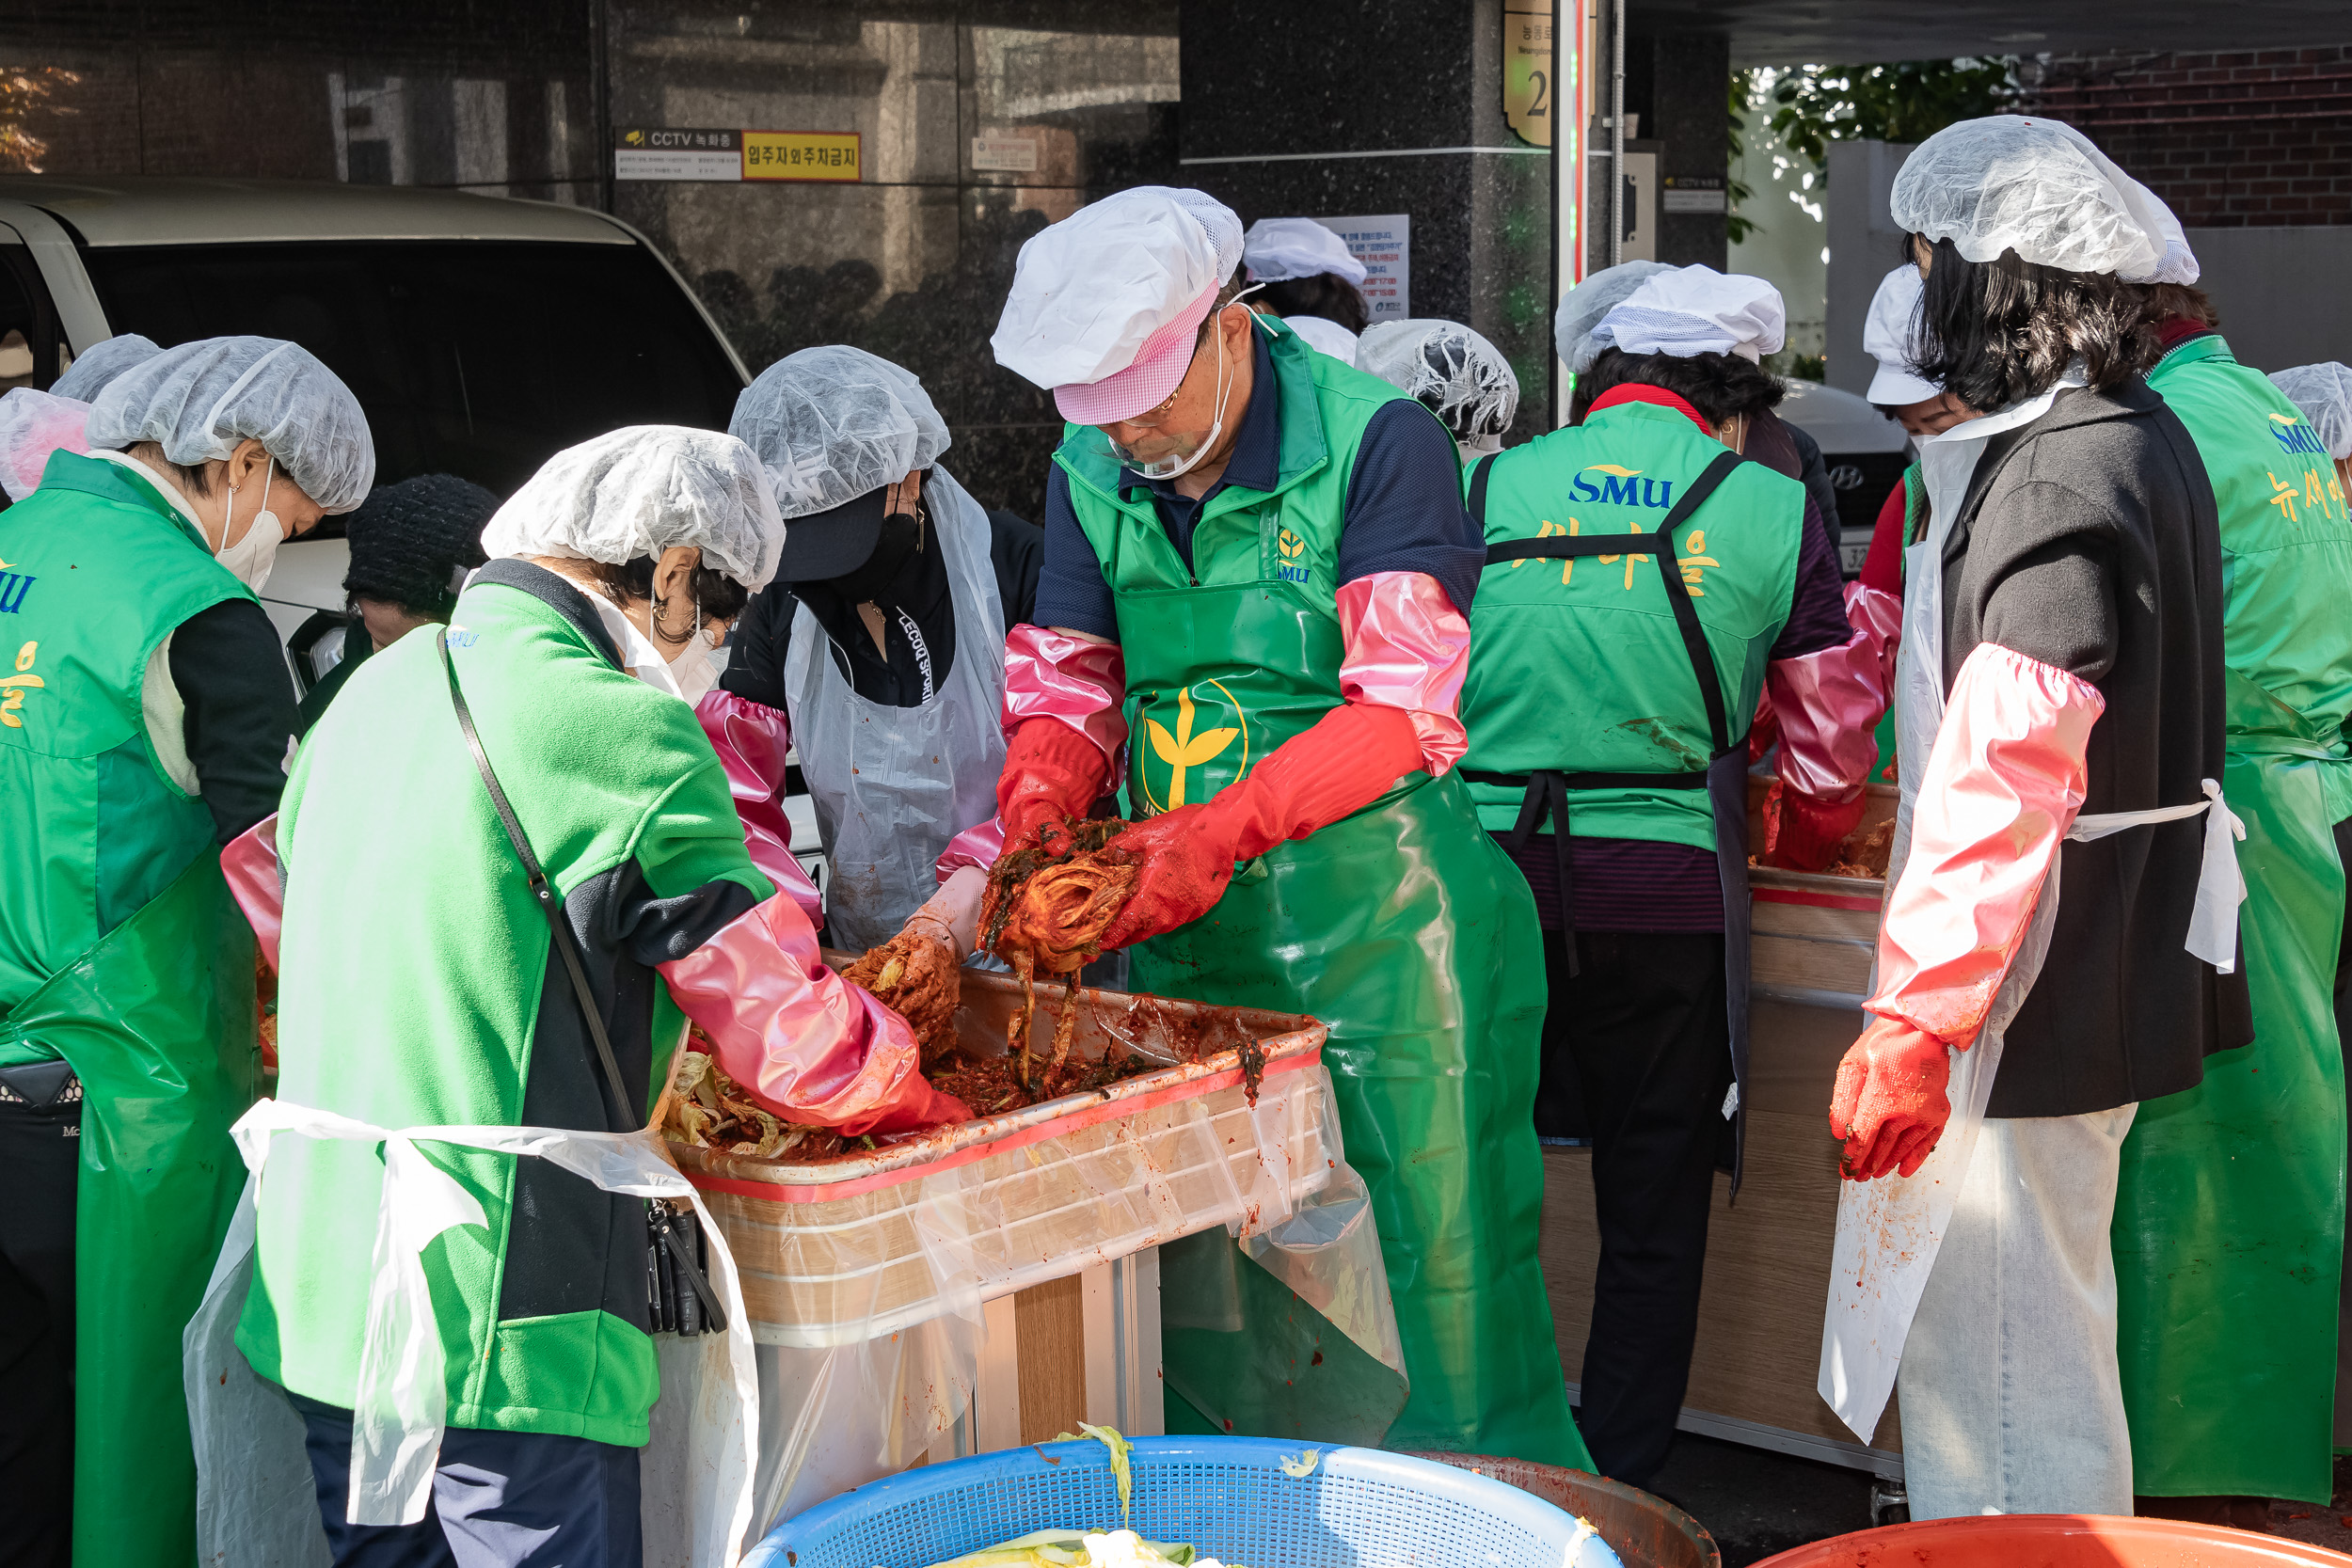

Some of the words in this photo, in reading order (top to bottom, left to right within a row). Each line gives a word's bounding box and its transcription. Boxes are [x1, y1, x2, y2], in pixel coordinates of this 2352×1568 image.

[651, 132, 691, 146] CCTV
[2268, 420, 2327, 454] SMU
[1568, 471, 1674, 510] SMU
